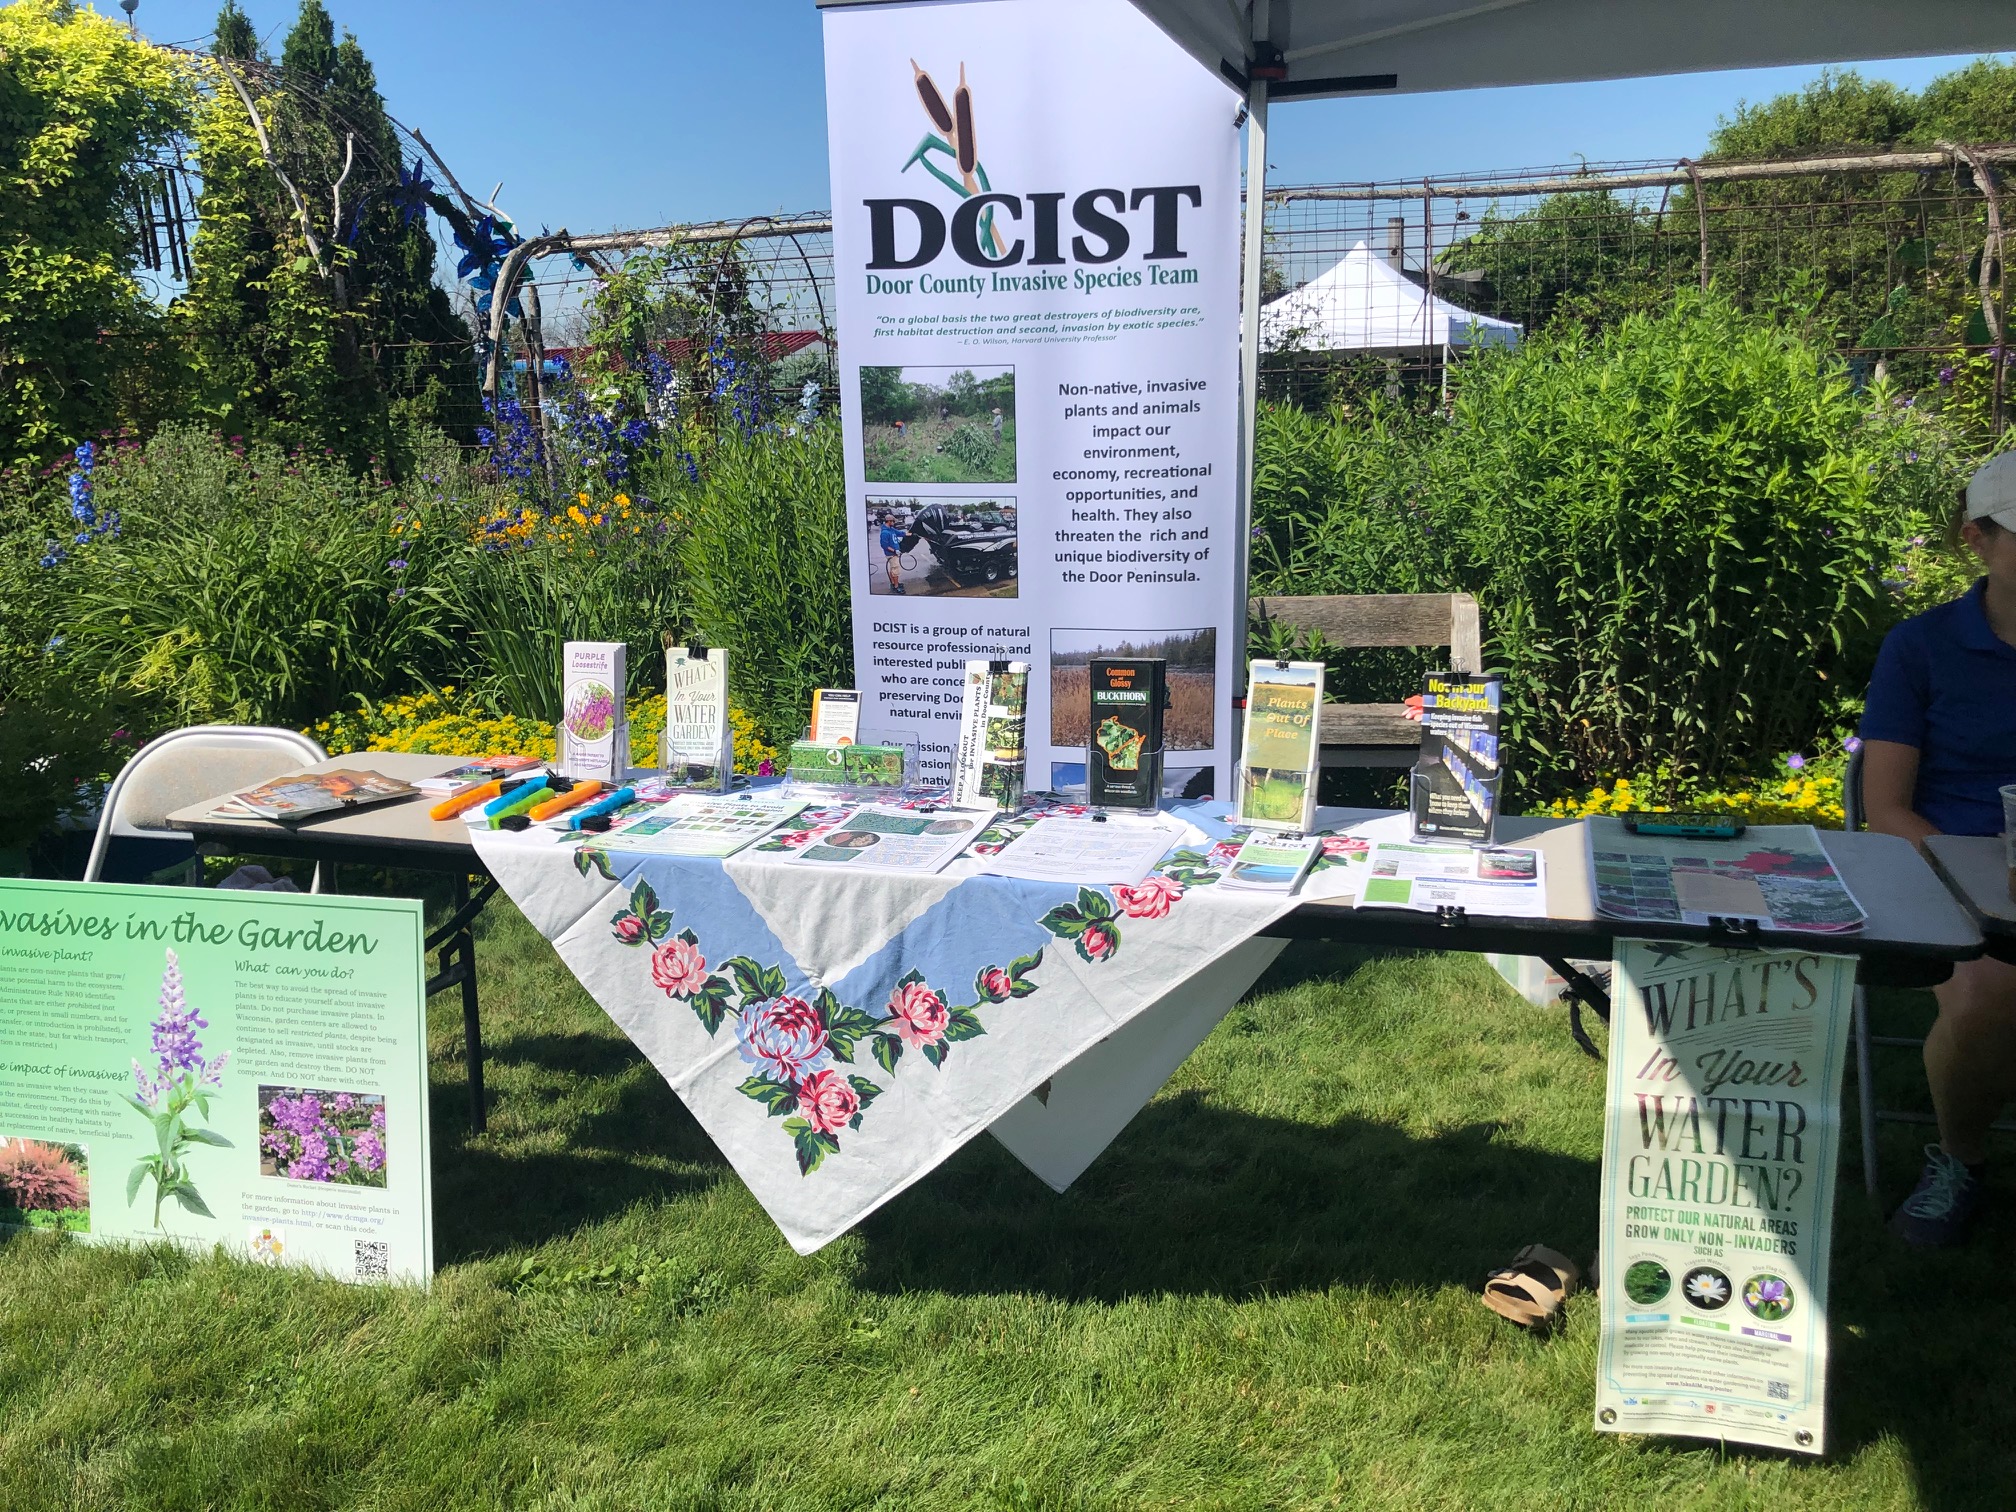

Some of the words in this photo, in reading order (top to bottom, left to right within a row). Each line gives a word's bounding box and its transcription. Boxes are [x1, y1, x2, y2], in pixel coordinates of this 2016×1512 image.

[862, 185, 1202, 270] DCIST
[865, 274, 913, 294] Door
[919, 273, 985, 298] County
[991, 269, 1067, 291] Invasive
[1073, 265, 1141, 294] Species
[1147, 264, 1198, 285] Team
[907, 314, 939, 325] global
[941, 314, 967, 323] basis
[970, 314, 987, 322] the
[1012, 313, 1041, 323] great
[1044, 311, 1098, 321] destroyers
[1101, 309, 1112, 319] of
[1114, 306, 1177, 317] biodiversity
[873, 327, 894, 338] first
[896, 327, 933, 336] habitat
[936, 326, 993, 335] destruction
[996, 325, 1016, 334] and
[1018, 324, 1058, 334] second,
[1061, 323, 1104, 332] invasion
[1107, 322, 1120, 332] by
[1122, 320, 1154, 329] exotic
[1043, 335, 1081, 343] University
[1082, 334, 1117, 342] Professor
[1059, 381, 1141, 395] Non-native,
[1147, 378, 1206, 392] invasive
[1064, 403, 1107, 419] plants
[1111, 402, 1138, 415] and
[1142, 399, 1200, 414] animals
[1093, 425, 1140, 440] impact
[1145, 425, 1170, 435] our
[1083, 445, 1179, 458] environment,
[1052, 470, 1119, 481] economy,
[1124, 462, 1211, 478] recreational
[1066, 487, 1165, 503] opportunities,
[1170, 485, 1197, 498] and
[1072, 508, 1119, 521] health.
[1123, 508, 1158, 523] They
[1162, 507, 1191, 520] also
[1054, 529, 1114, 541] threaten
[1118, 529, 1141, 541] the
[1150, 528, 1176, 541] rich
[1181, 526, 1208, 540] and
[1054, 550, 1102, 564] unique
[1106, 549, 1190, 563] biodiversity
[1194, 547, 1209, 560] of
[1061, 570, 1085, 582] the
[1089, 570, 1122, 582] Door
[1127, 569, 1200, 582] Peninsula.
[873, 622, 907, 633] DCIST
[910, 623, 919, 633] is
[922, 626, 929, 634] a
[932, 626, 967, 637] group
[970, 625, 983, 635] of
[987, 626, 1029, 636] natural
[872, 641, 923, 651] resource
[1008, 644, 1031, 654] and
[574, 652, 605, 661] PURPLE
[873, 655, 932, 668] interested
[936, 658, 965, 671] publi
[572, 660, 608, 670] Loosestrife
[1106, 667, 1136, 677] Common
[674, 661, 717, 689] WHAT'S
[881, 673, 906, 683] who
[910, 676, 928, 685] are
[932, 677, 965, 686] conce
[1109, 678, 1132, 689] Glossy
[674, 691, 686, 701] In
[689, 691, 716, 705] Your
[879, 691, 940, 704] preserving
[973, 686, 982, 716] PLANTS
[1096, 691, 1147, 701] BUCKTHORN
[1267, 697, 1309, 709] Plants
[1436, 694, 1488, 712] Backyard
[674, 705, 716, 724] WATER
[890, 708, 930, 718] natural
[934, 710, 962, 720] envir
[1266, 712, 1289, 723] Out
[1293, 714, 1311, 727] Of
[1431, 713, 1451, 722] Keeping
[673, 725, 715, 740] GARDEN?
[970, 717, 979, 759] INVASIVE
[1264, 728, 1298, 740] Place
[960, 735, 969, 772] LOOKOUT
[959, 772, 965, 780] A
[956, 781, 965, 803] KEEP
[0, 907, 119, 940] vasives
[125, 912, 168, 940] in
[171, 911, 234, 944] the
[238, 919, 378, 954] Garden
[1, 948, 52, 958] invasive
[53, 949, 93, 963] plant?
[234, 960, 270, 973] What
[275, 965, 302, 975] can
[302, 968, 329, 979] you
[330, 966, 354, 979] do?
[234, 980, 247, 990] The
[248, 981, 263, 989] best
[358, 990, 387, 998] invasive
[1640, 956, 1819, 1039] WHAT'S
[9, 1061, 52, 1076] impact
[53, 1064, 67, 1078] of
[68, 1066, 129, 1081] invasives?
[1636, 1047, 1681, 1082] In
[1696, 1048, 1808, 1095] Your
[1634, 1093, 1806, 1164] WATER
[1629, 1155, 1802, 1211] GARDEN?
[1626, 1206, 1674, 1222] PROTECT
[1678, 1210, 1699, 1225] OUR
[1704, 1213, 1755, 1231] NATURAL
[1759, 1217, 1797, 1236] AREAS
[1625, 1224, 1659, 1238] GROW
[1664, 1227, 1693, 1242] ONLY
[1693, 1245, 1712, 1256] SUCH
[1713, 1248, 1723, 1257] AS
